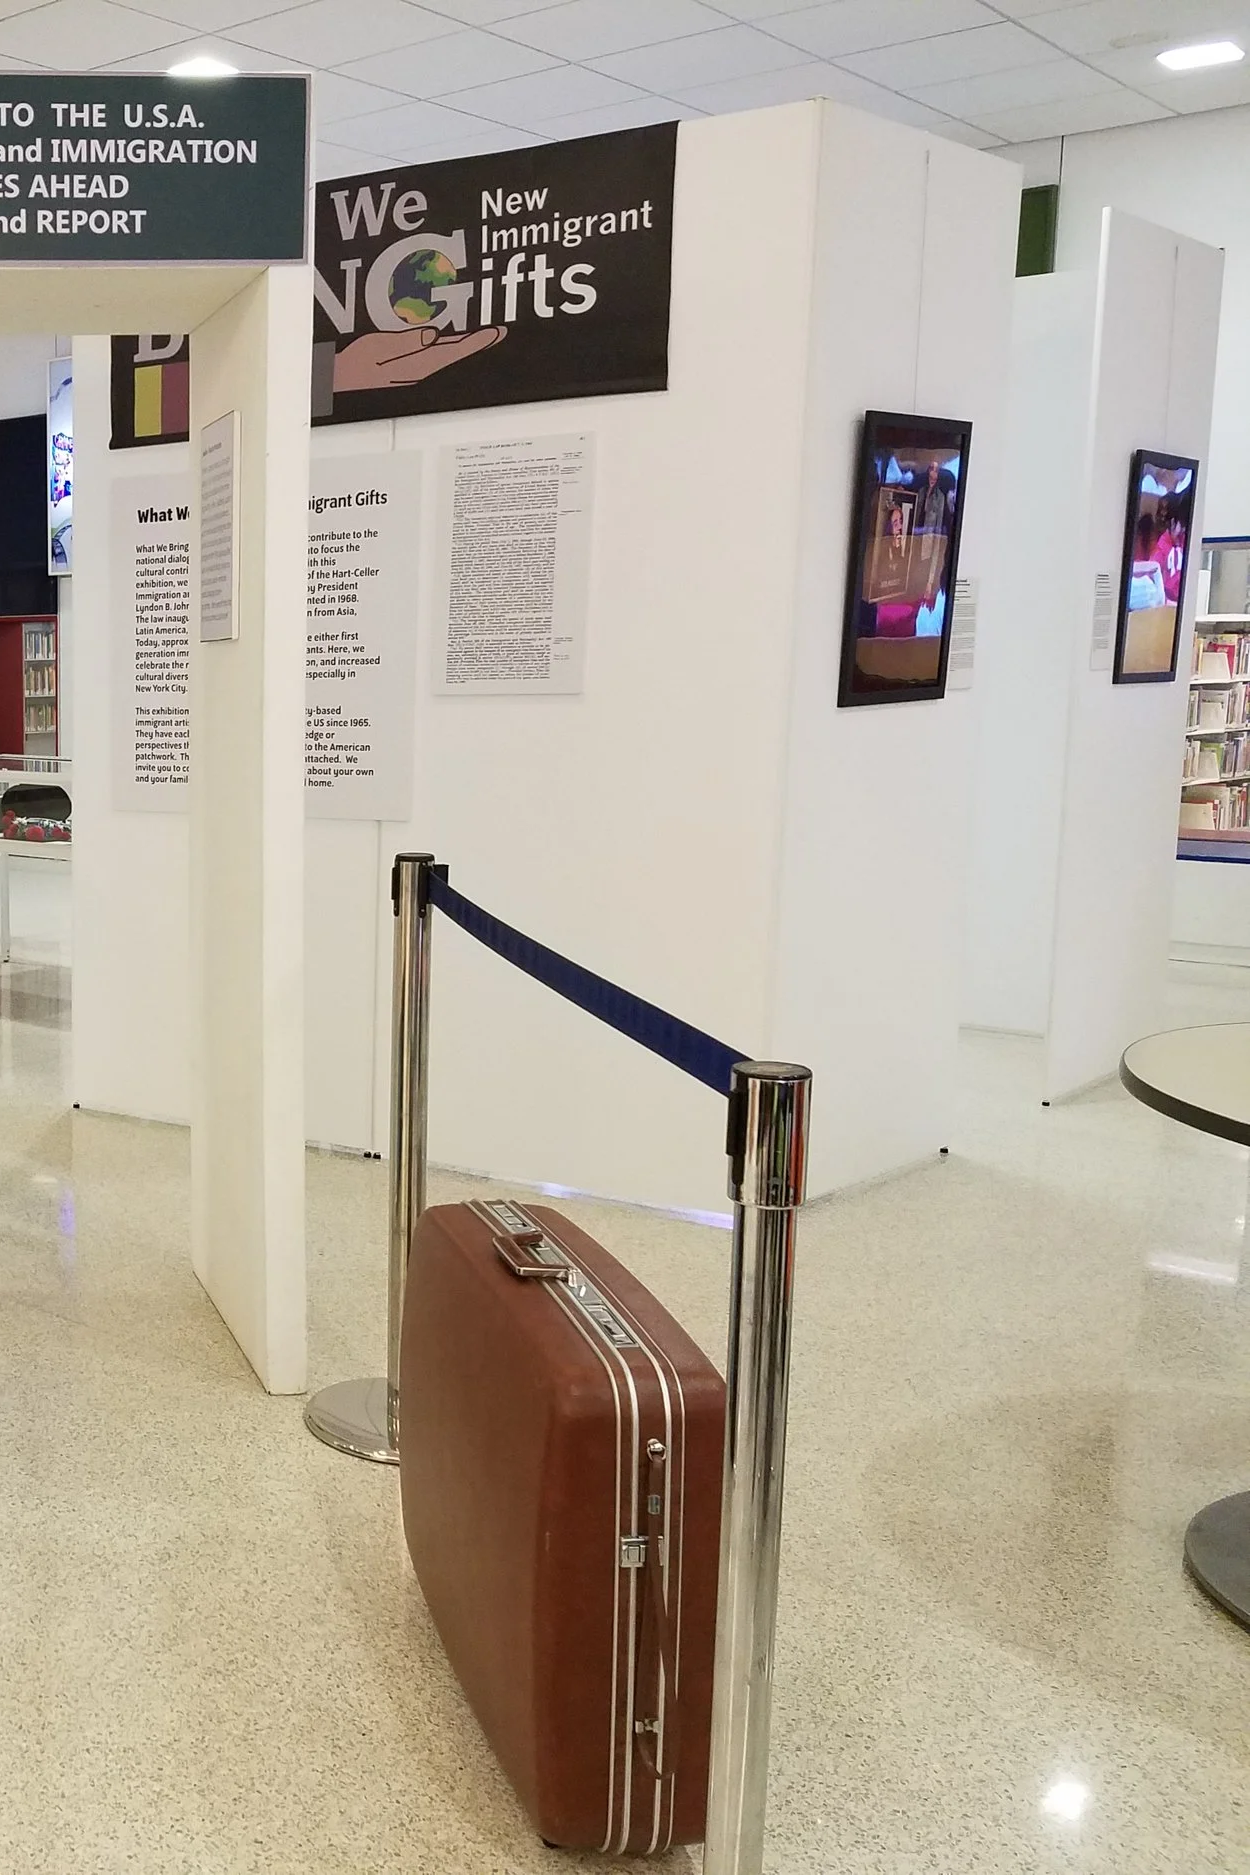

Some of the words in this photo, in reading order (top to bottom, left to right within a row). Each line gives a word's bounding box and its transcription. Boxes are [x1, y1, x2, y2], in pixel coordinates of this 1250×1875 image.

[51, 103, 107, 128] THE
[123, 104, 205, 129] U.S.A.
[51, 139, 258, 164] IMMIGRATION
[28, 174, 130, 199] AHEAD
[481, 187, 549, 220] New
[330, 181, 429, 241] We
[37, 210, 147, 234] REPORT
[481, 200, 653, 254] Immigrant
[365, 229, 598, 332] Gifts
[308, 494, 353, 514] igrant
[355, 489, 388, 506] Gifts
[137, 507, 174, 524] What
[176, 506, 190, 521] W
[352, 531, 362, 539] to
[364, 528, 378, 538] the
[136, 544, 155, 553] What
[156, 543, 168, 552] We
[169, 542, 189, 553] Bring
[320, 544, 344, 554] focus
[346, 542, 360, 552] the
[136, 555, 166, 565] national
[320, 557, 336, 566] this
[136, 567, 165, 577] cultural
[316, 570, 330, 579] the
[332, 567, 380, 578] Hart-Celler
[136, 579, 176, 589] exhibition,
[177, 579, 189, 587] we
[317, 581, 358, 592] President
[136, 591, 182, 602] Immigration
[327, 595, 335, 604] in
[337, 594, 359, 603] 1968.
[136, 602, 164, 614] Lyndon
[314, 607, 335, 617] from
[336, 606, 357, 616] Asia,
[136, 615, 149, 623] The
[151, 614, 164, 623] law
[136, 627, 154, 635] Latin
[155, 626, 189, 635] America,
[314, 632, 339, 641] either
[341, 630, 359, 640] first
[135, 638, 160, 648] Today,
[162, 639, 189, 648] approx
[327, 645, 350, 653] Here,
[352, 645, 365, 653] we
[135, 650, 176, 660] generation
[135, 661, 171, 670] celebrate
[172, 660, 184, 669] the
[320, 657, 336, 666] and
[337, 655, 381, 665] increased
[135, 672, 164, 681] cultural
[165, 672, 189, 681] divers
[347, 669, 356, 678] in
[136, 684, 152, 692] New
[152, 683, 170, 692] York
[171, 684, 189, 694] City.
[135, 707, 150, 715] This
[151, 707, 189, 715] exhibition
[135, 718, 173, 728] immigrant
[313, 718, 324, 727] US
[326, 718, 348, 727] since
[350, 718, 371, 727] 1965.
[135, 730, 153, 740] They
[154, 730, 173, 738] have
[135, 741, 182, 751] perspectives
[314, 742, 328, 751] the
[330, 743, 371, 751] American
[135, 752, 177, 762] patchwork.
[345, 755, 358, 763] We
[135, 763, 156, 771] invite
[157, 765, 171, 773] you
[307, 766, 331, 775] about
[333, 768, 354, 777] your
[355, 768, 374, 776] own
[135, 774, 149, 782] and
[150, 776, 168, 785] your
[308, 778, 334, 787] home.
